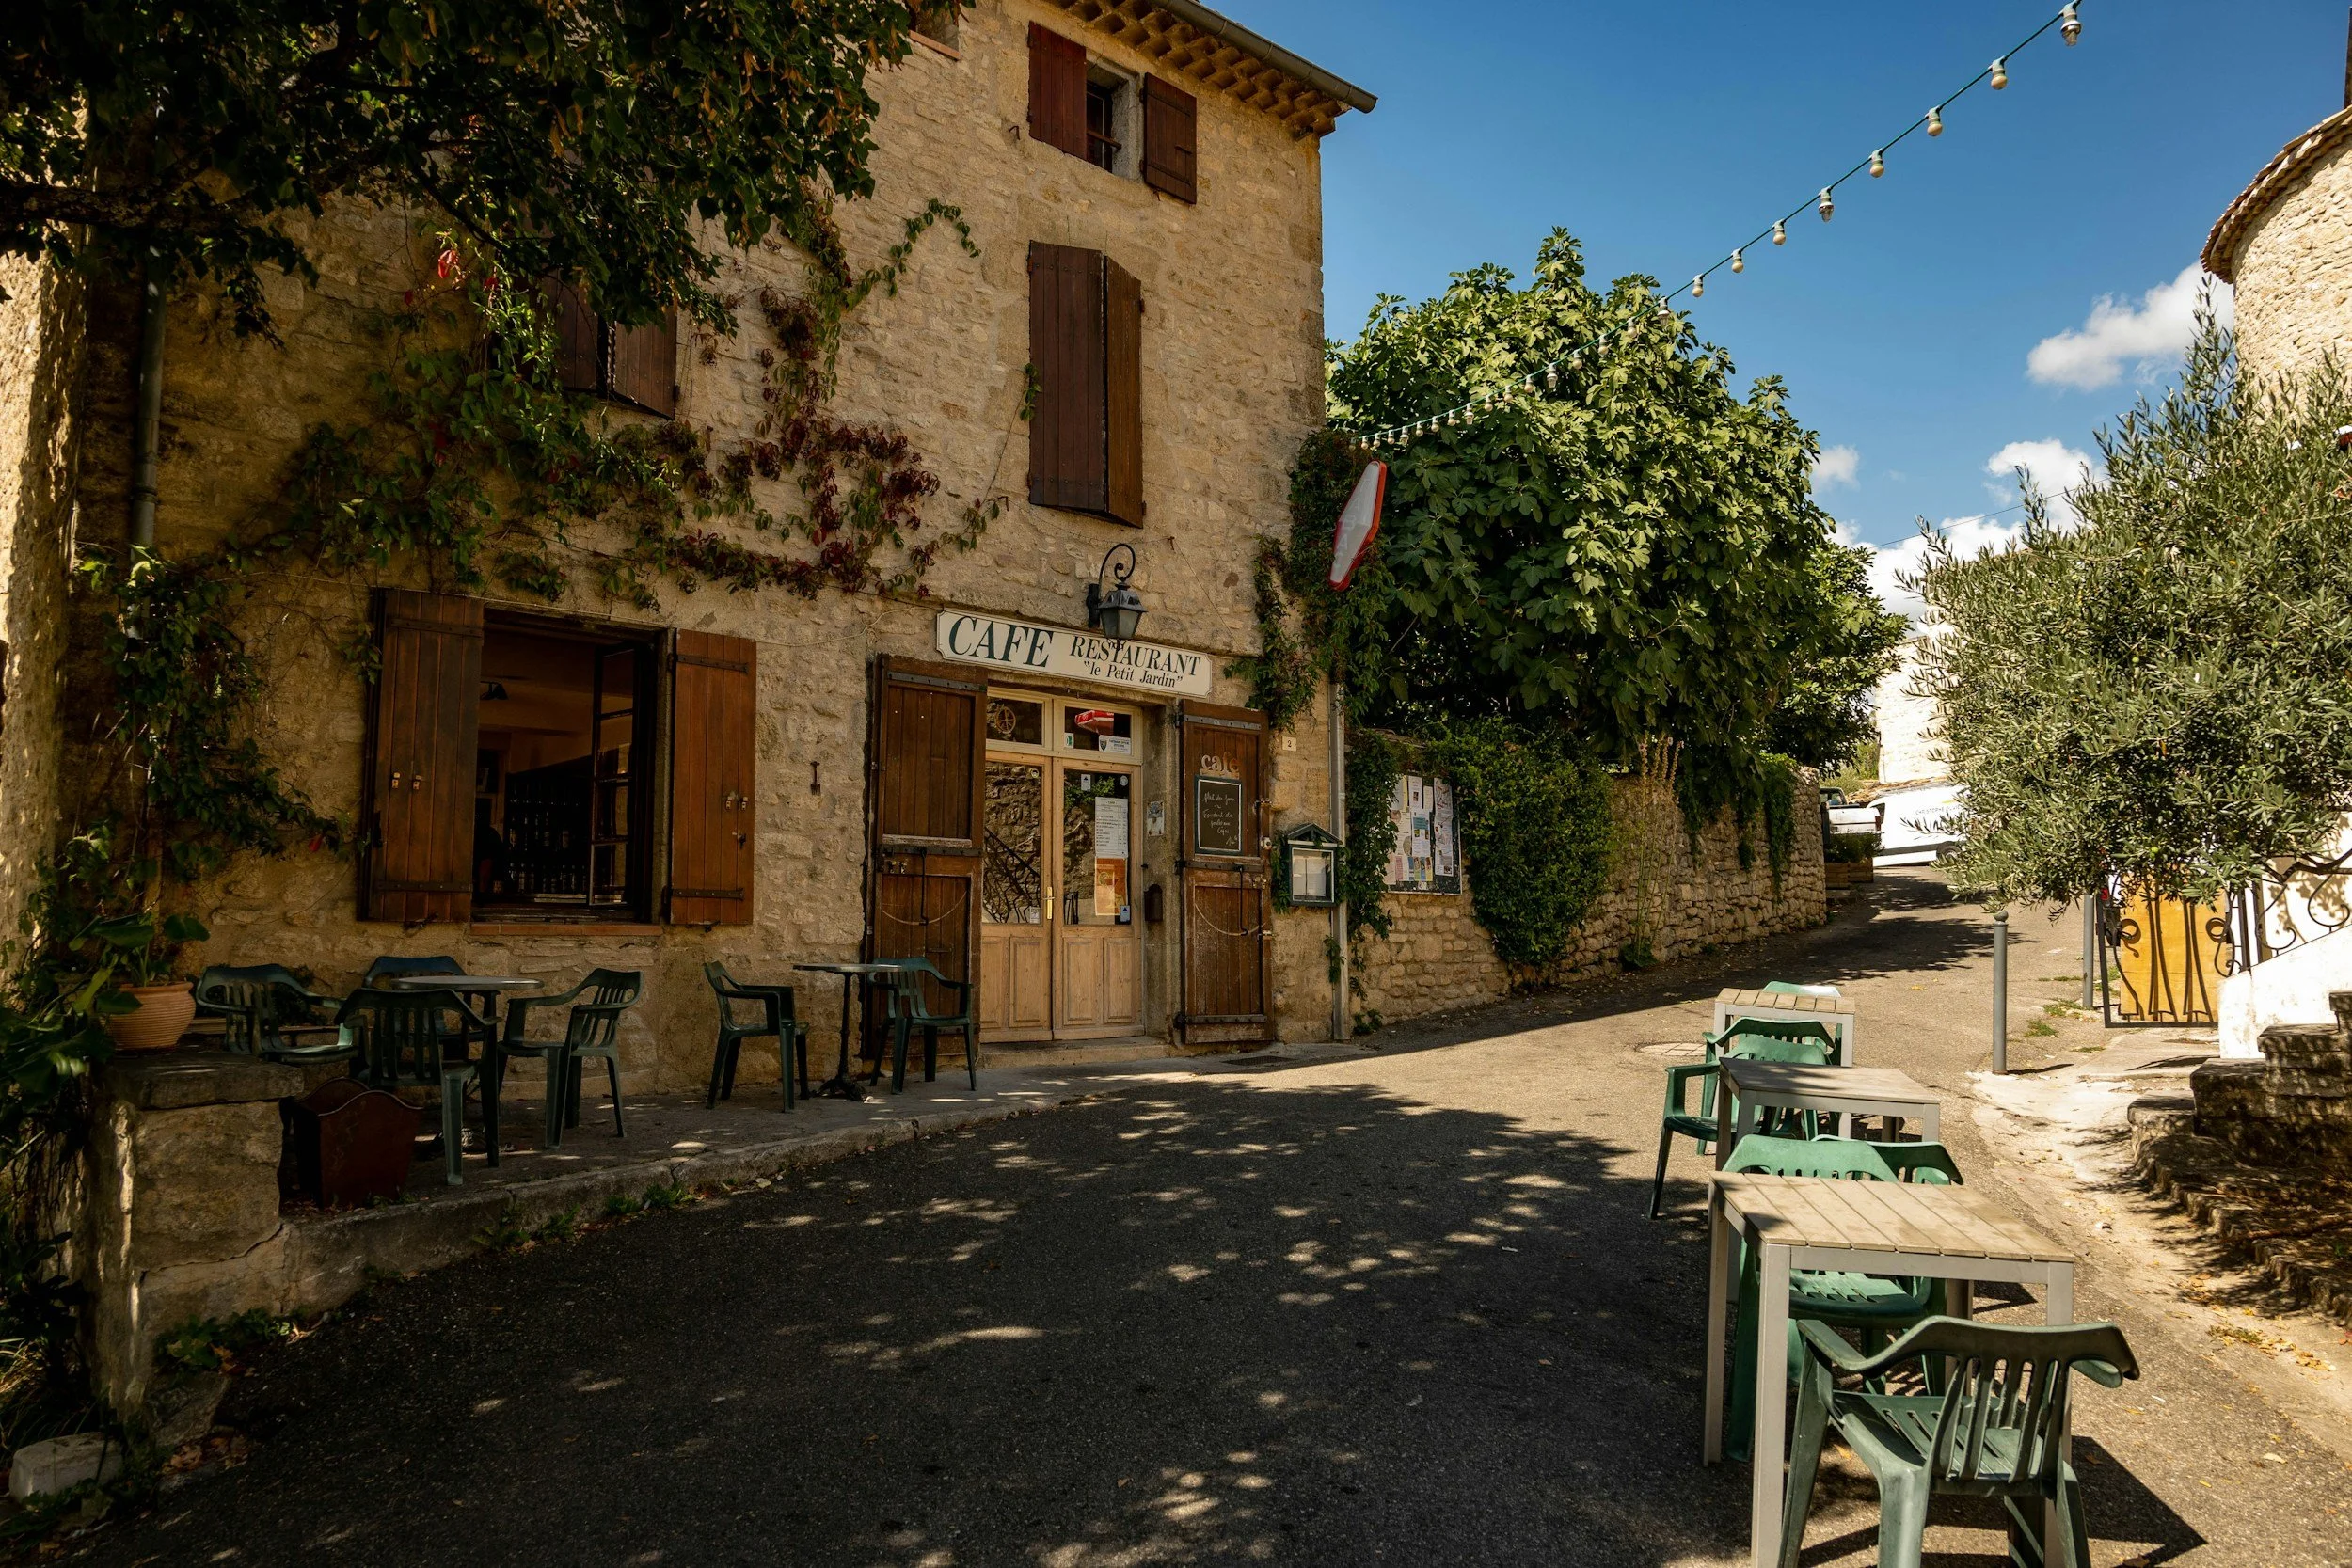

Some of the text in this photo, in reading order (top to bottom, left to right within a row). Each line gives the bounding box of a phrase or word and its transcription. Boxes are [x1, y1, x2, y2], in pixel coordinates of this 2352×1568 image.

[949, 616, 1201, 676] CAFE RESTAURANT
[1106, 664, 1135, 682] Petit
[1287, 739, 1293, 748] 2
